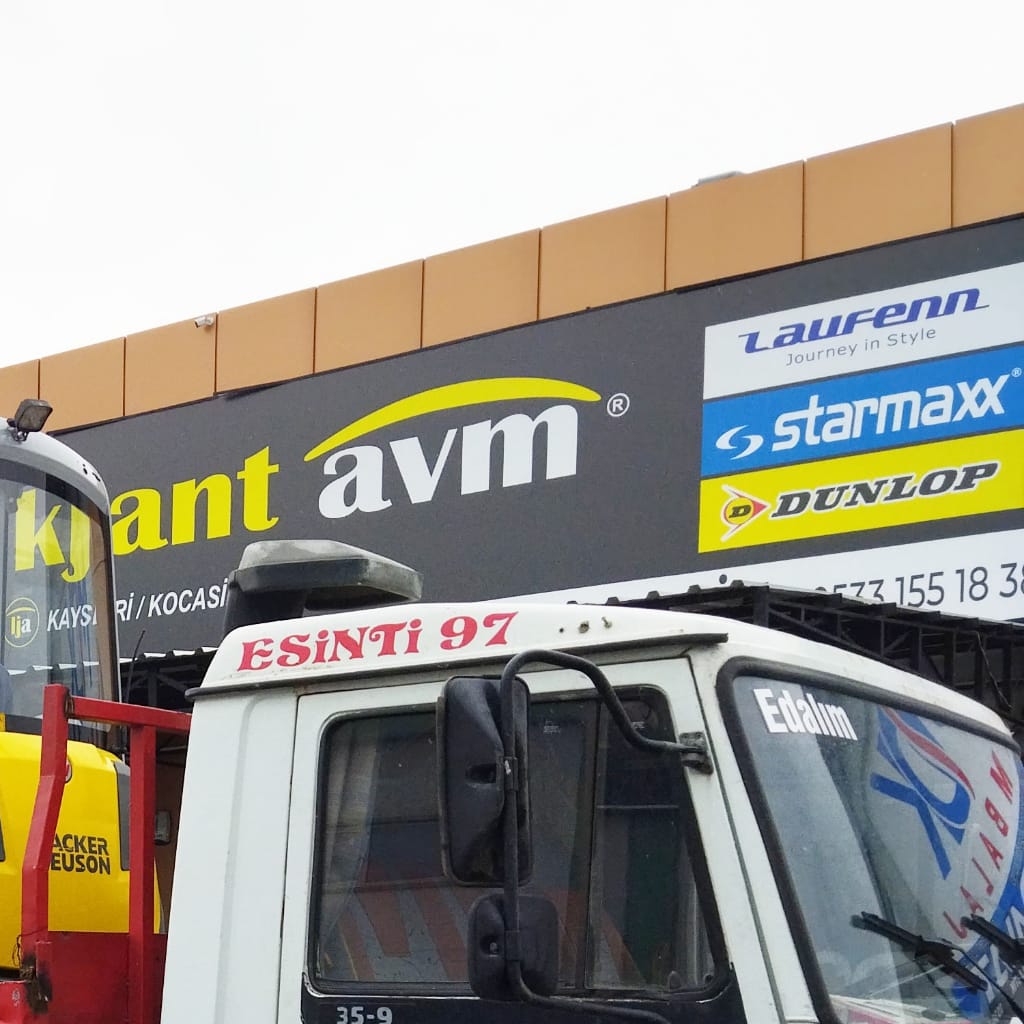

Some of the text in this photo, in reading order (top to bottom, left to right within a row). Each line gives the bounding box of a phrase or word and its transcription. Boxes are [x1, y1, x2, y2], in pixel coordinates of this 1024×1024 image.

[786, 328, 937, 367] Journey in Style
[318, 404, 579, 520] avm
[770, 462, 1000, 519] DUNLOP
[895, 571, 945, 607] 155
[955, 566, 989, 602] 18
[47, 592, 134, 632] KAYSRİ
[440, 611, 519, 650] 97
[51, 853, 111, 875] EUSON
[52, 834, 110, 856] ACKER
